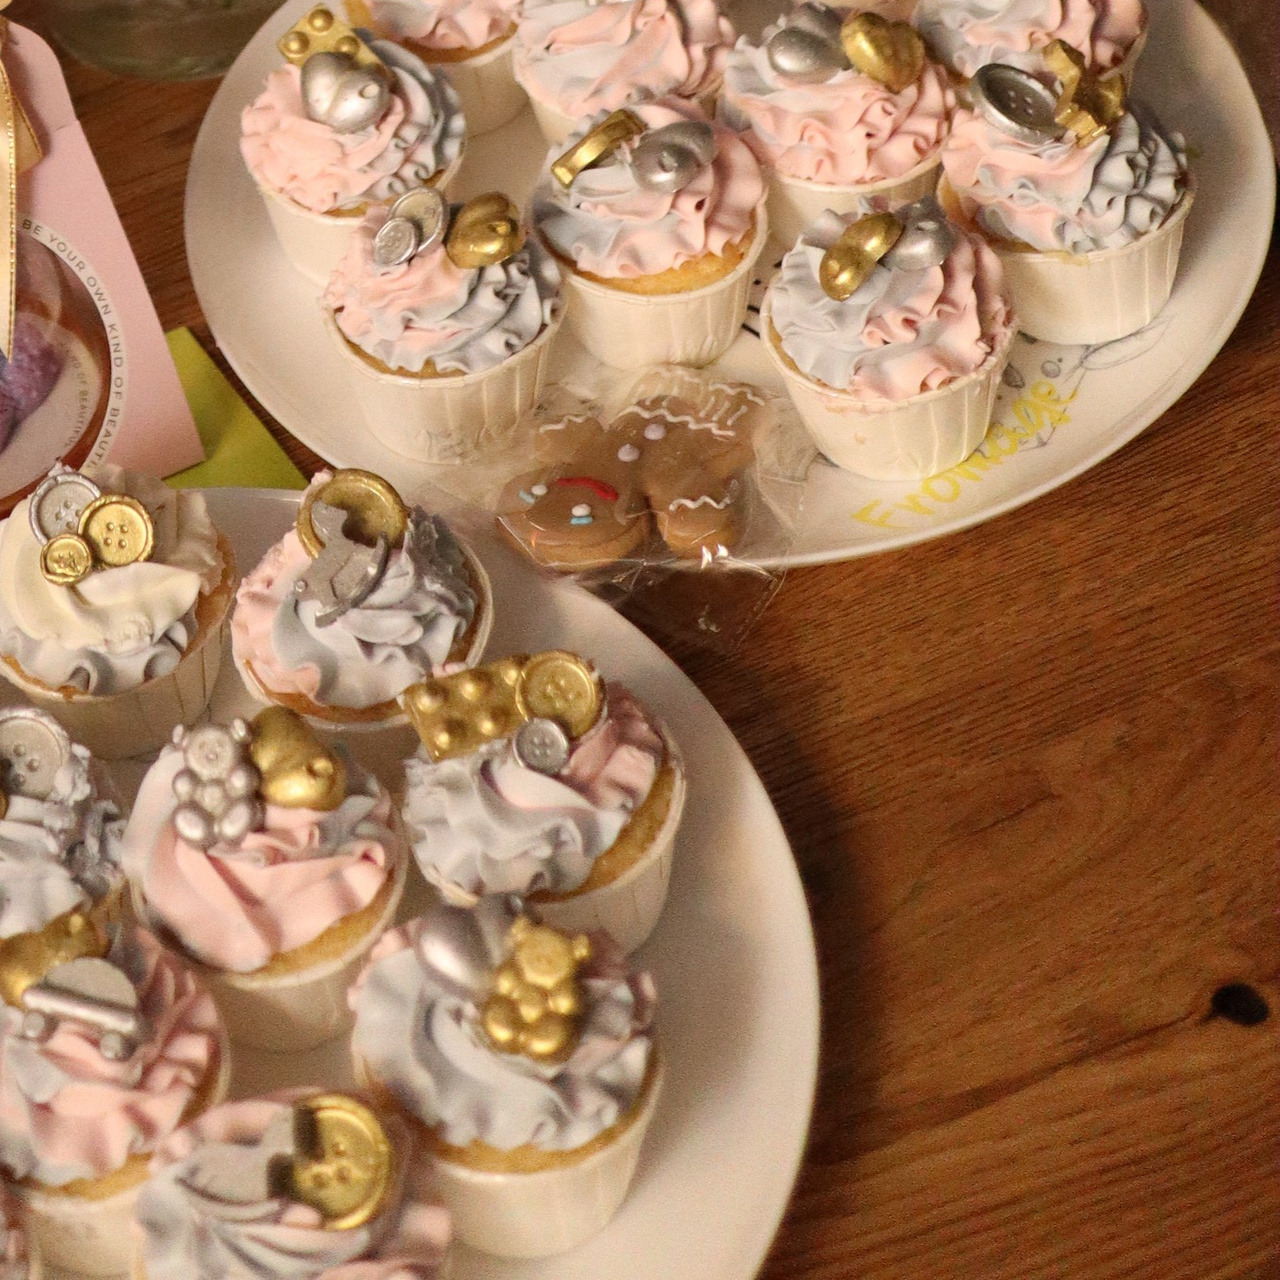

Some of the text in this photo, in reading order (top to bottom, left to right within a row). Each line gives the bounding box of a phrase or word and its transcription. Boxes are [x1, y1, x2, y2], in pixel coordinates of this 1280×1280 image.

[22, 219, 124, 469] BE YOUR OWN KIND OF BEAUTI
